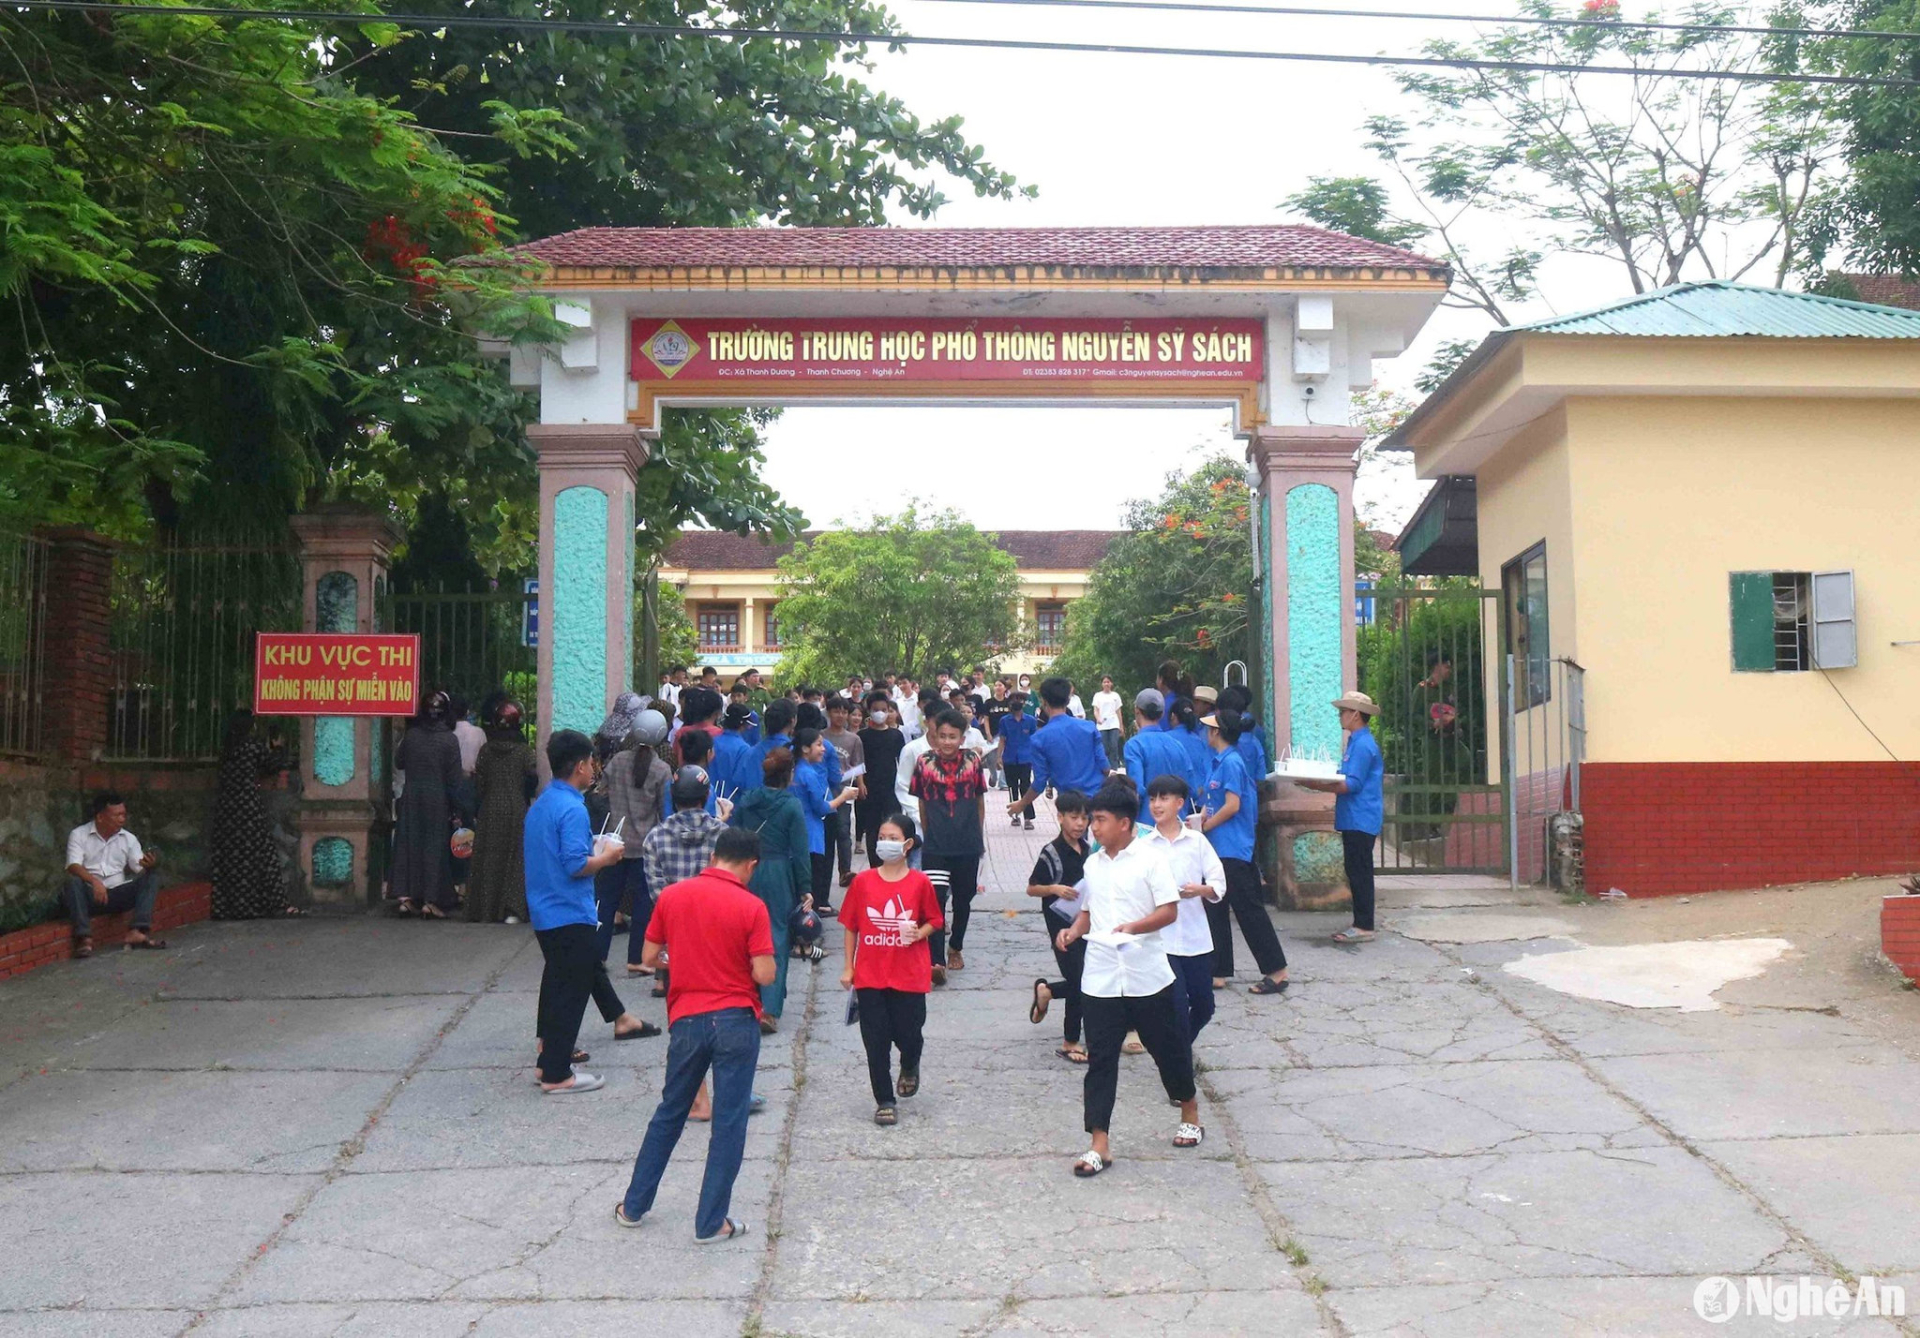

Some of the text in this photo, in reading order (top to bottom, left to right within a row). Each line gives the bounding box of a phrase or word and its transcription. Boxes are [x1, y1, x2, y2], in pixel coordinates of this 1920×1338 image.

[708, 324, 794, 361] TRƯỜNG
[800, 331, 874, 361] TRUNG
[880, 330, 925, 366] HỌC
[932, 320, 978, 361] PHỔ
[982, 324, 1055, 361] THÔNG
[1062, 321, 1150, 362] NGUYỄN
[1192, 325, 1252, 362] SÁCH
[746, 368, 769, 376] Thanh
[806, 368, 830, 376] Thanh
[894, 368, 905, 376] An
[1092, 368, 1117, 376] Gmail:
[264, 644, 412, 670] KHU VỰC THI
[261, 672, 412, 705] KHÔNG PHẬN SỰ MIỄN VÀO
[864, 933, 908, 947] adida
